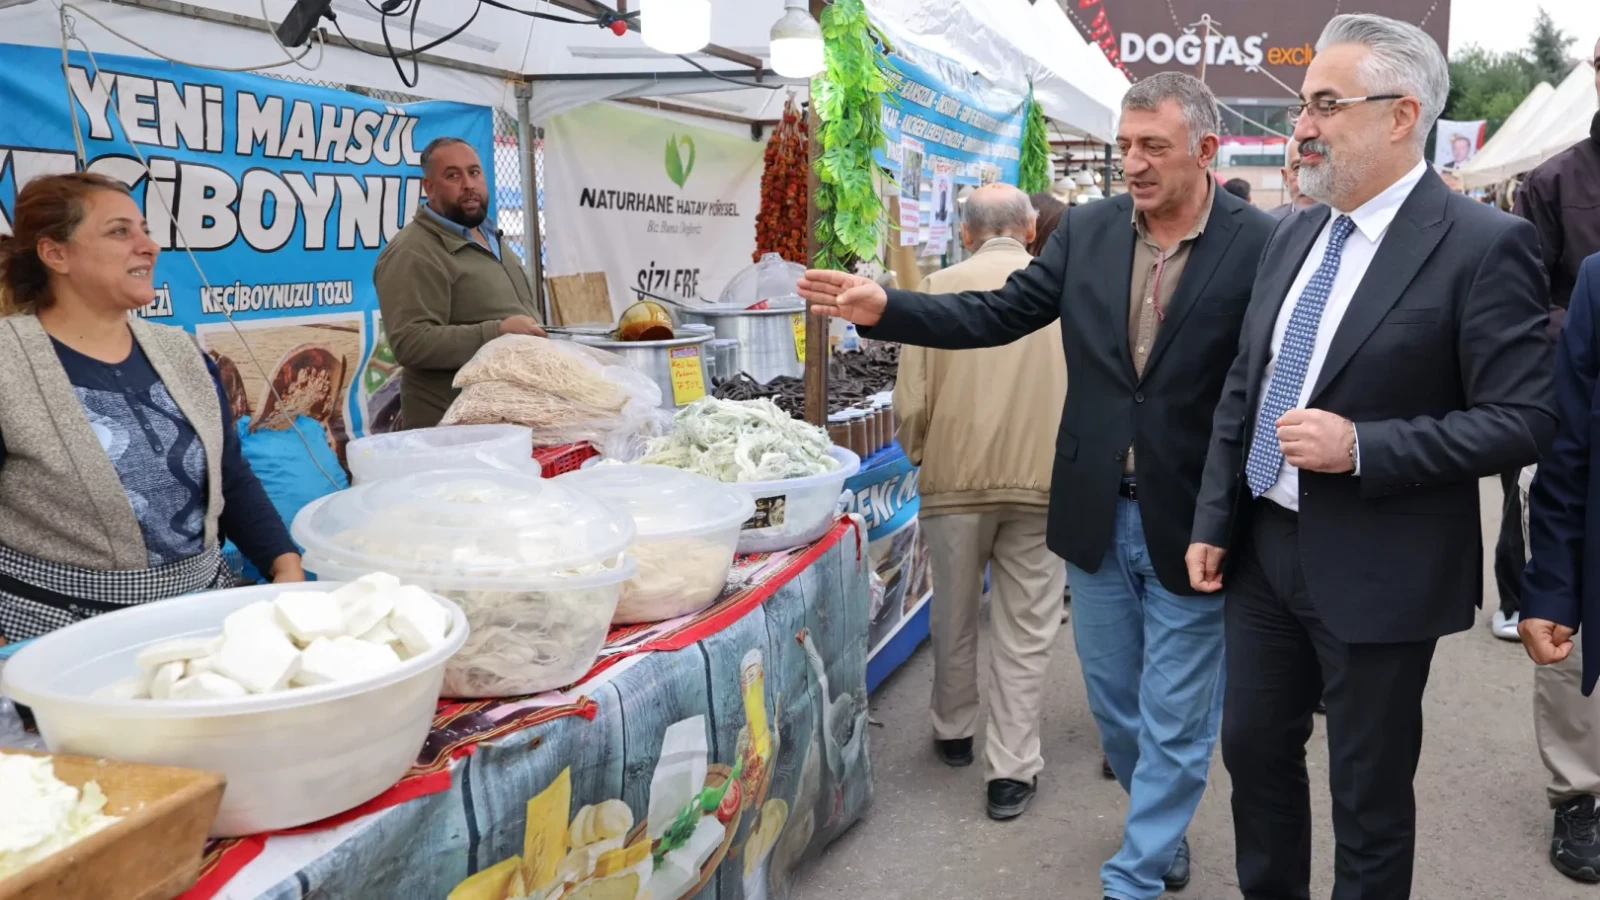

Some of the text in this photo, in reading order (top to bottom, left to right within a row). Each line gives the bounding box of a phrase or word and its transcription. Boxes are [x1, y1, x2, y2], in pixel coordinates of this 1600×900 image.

[1120, 27, 1263, 73] DOĞTAŞ
[63, 64, 423, 168] YENİ MAHSÜL
[579, 187, 674, 214] NATURHANE
[676, 199, 707, 215] HATAY
[316, 280, 353, 306] TOZU
